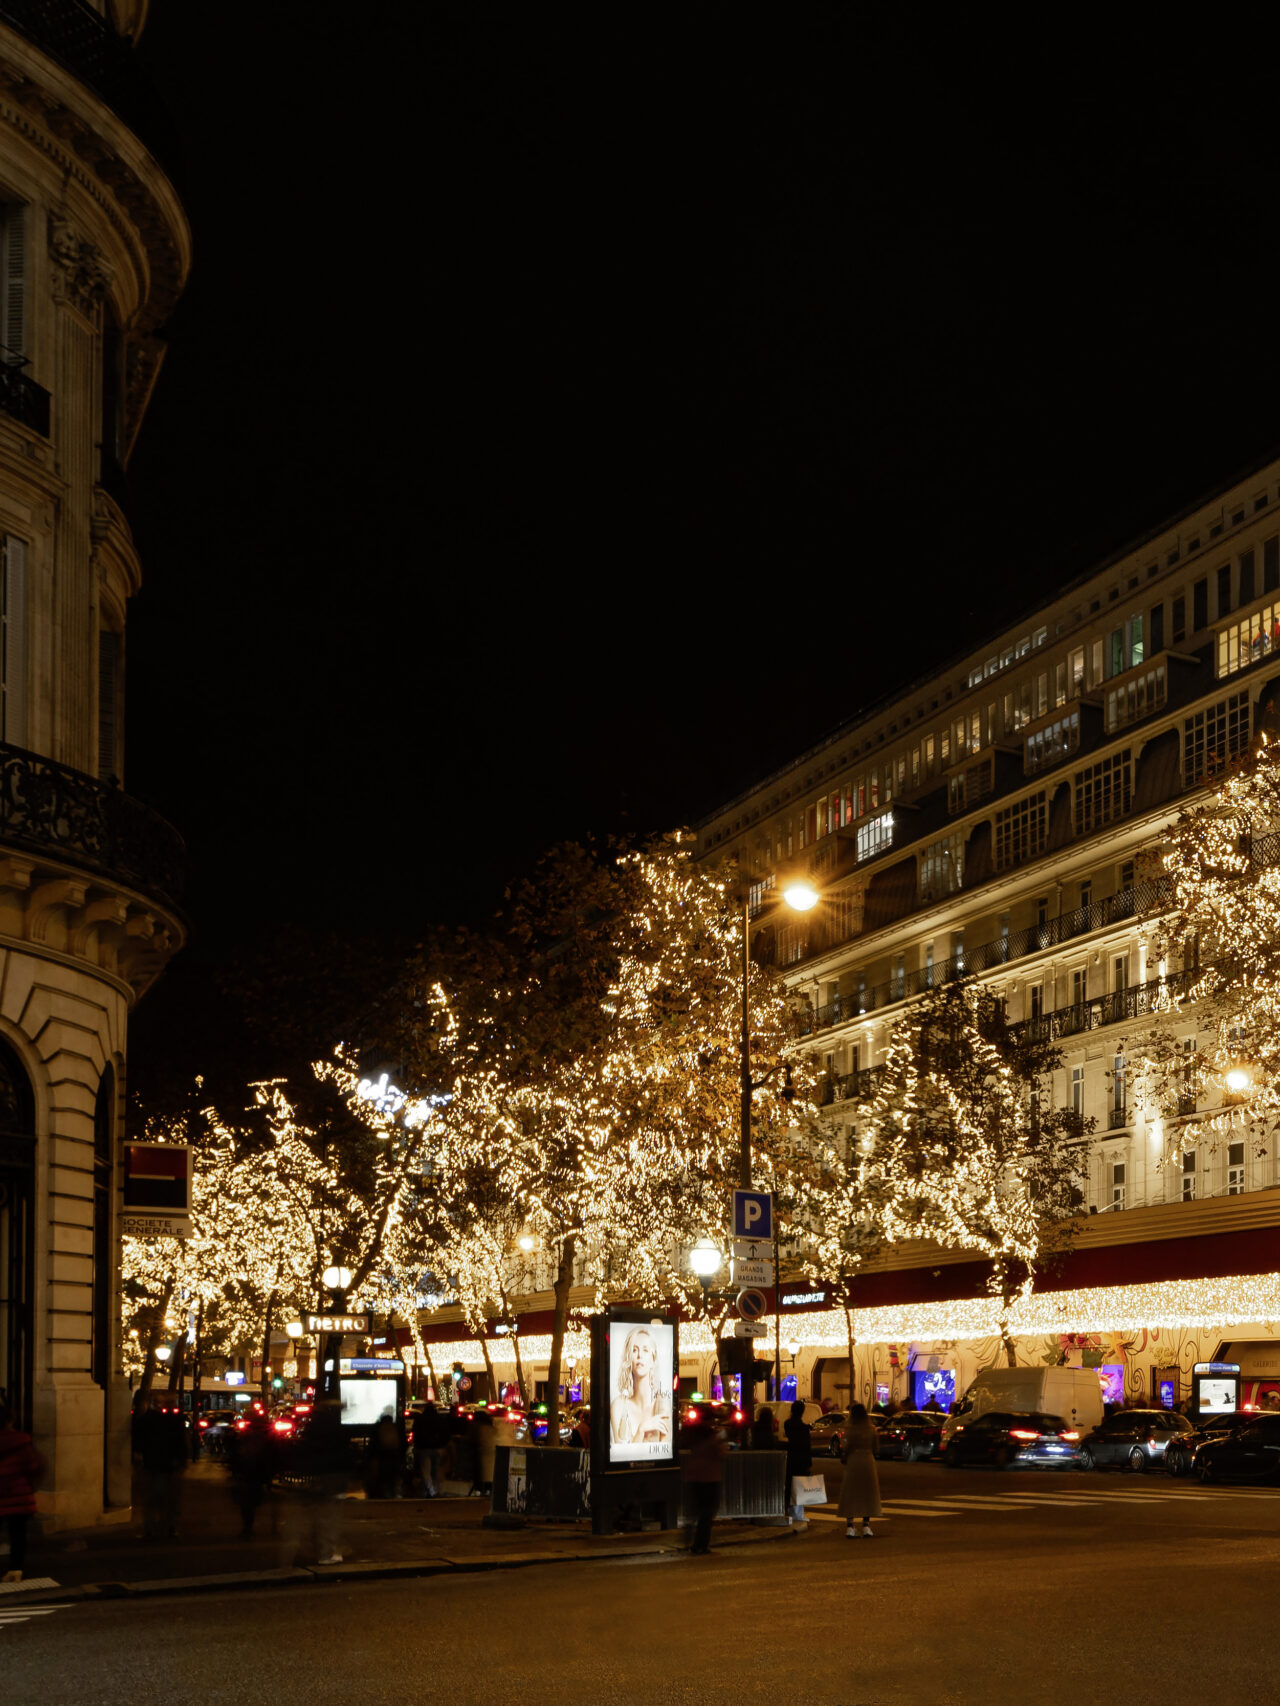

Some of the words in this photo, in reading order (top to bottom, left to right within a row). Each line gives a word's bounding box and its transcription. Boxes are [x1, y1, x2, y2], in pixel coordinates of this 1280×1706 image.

[744, 1200, 762, 1229] P
[740, 1265, 764, 1274] GRANDS
[737, 1275, 767, 1284] MAGASINS
[649, 1444, 670, 1455] DIOR
